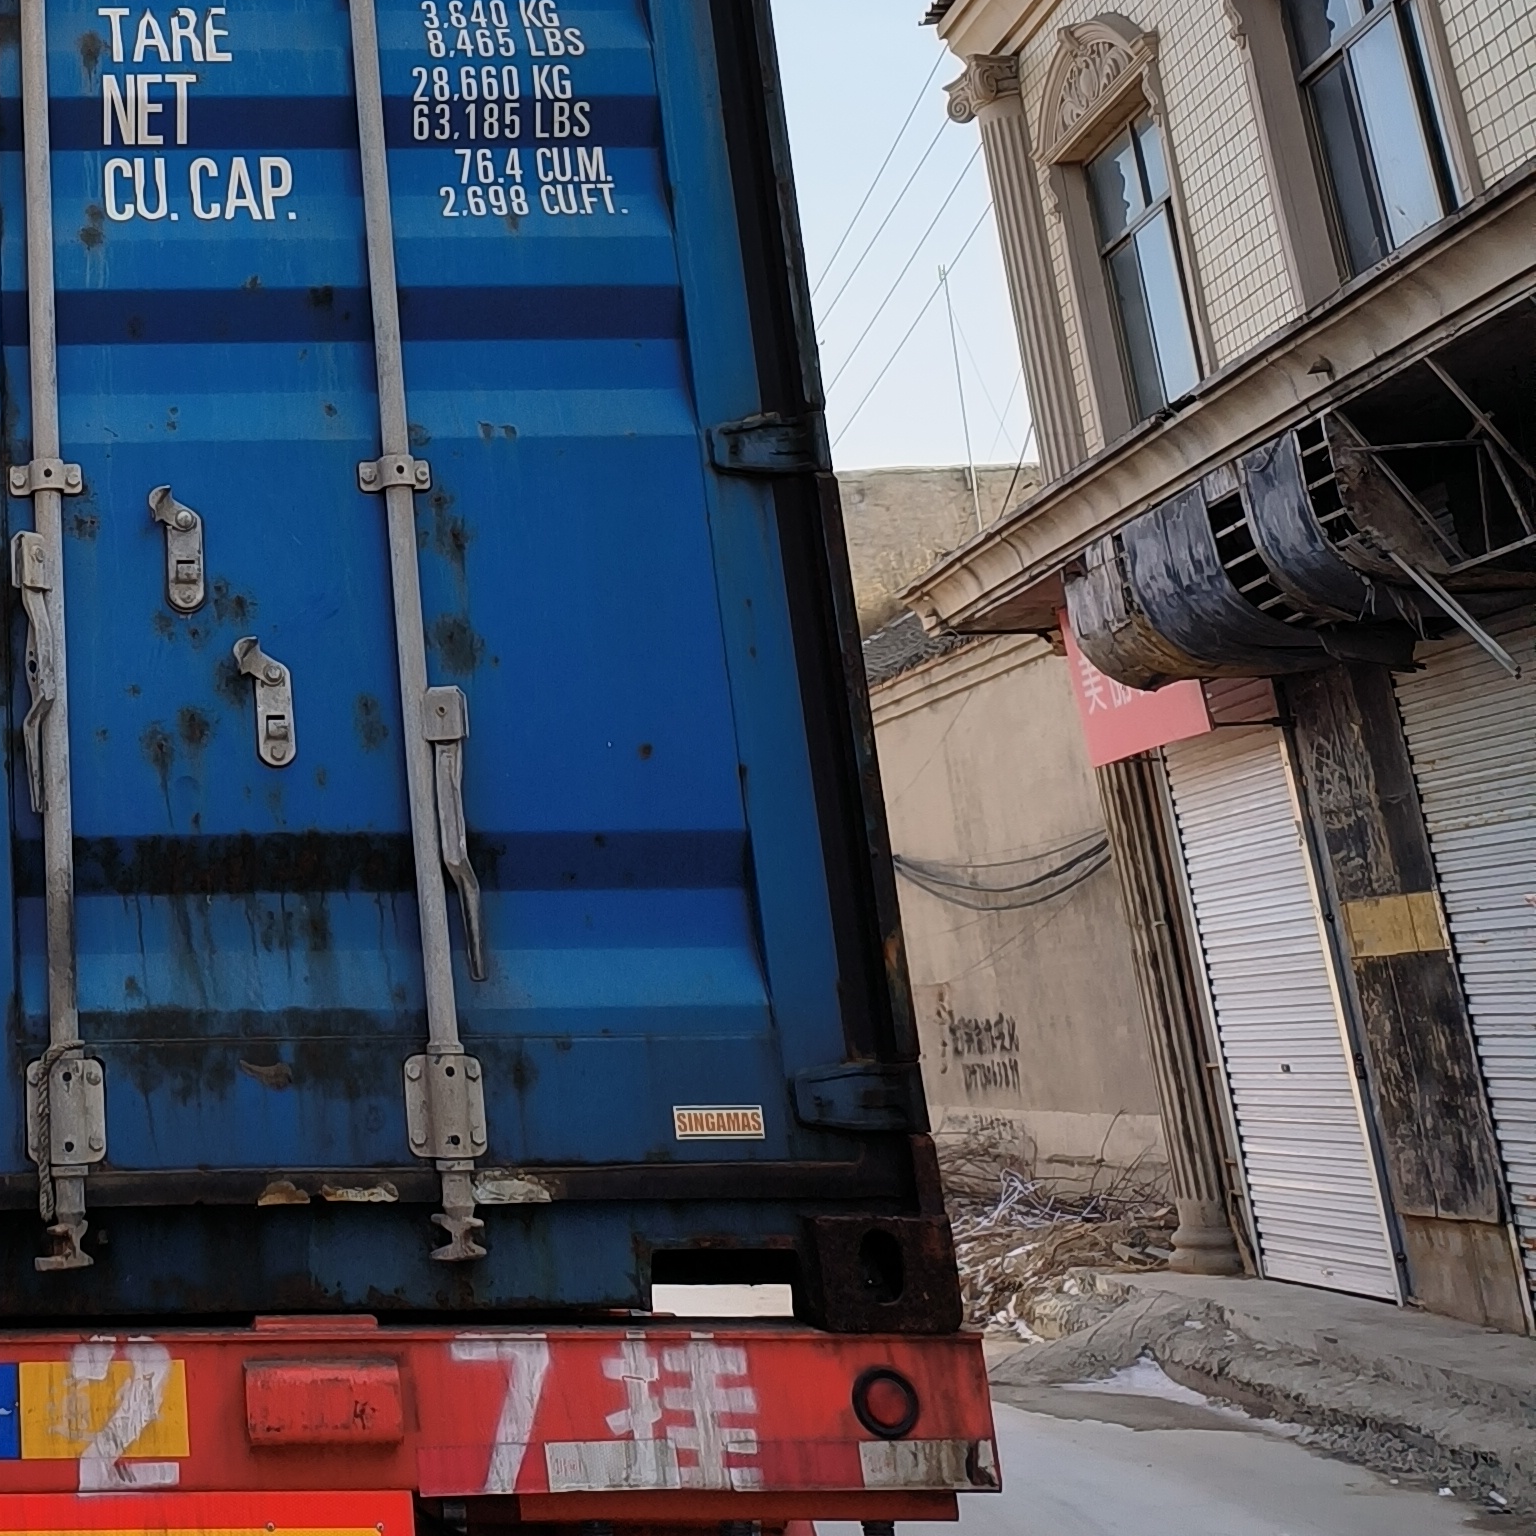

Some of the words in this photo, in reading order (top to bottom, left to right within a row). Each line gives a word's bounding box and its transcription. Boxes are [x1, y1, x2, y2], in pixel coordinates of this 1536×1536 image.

[98, 7, 233, 62] TARE
[427, 28, 516, 58] 8,465
[525, 27, 586, 57] LBS
[102, 74, 197, 145] NET
[412, 65, 520, 102] 28,660
[532, 64, 572, 100] KG
[413, 102, 520, 141] 63,185
[535, 101, 591, 139] LBS
[454, 147, 523, 184] 76.4
[439, 184, 529, 217] 2,698
[676, 1111, 762, 1133] SINGAMAS
